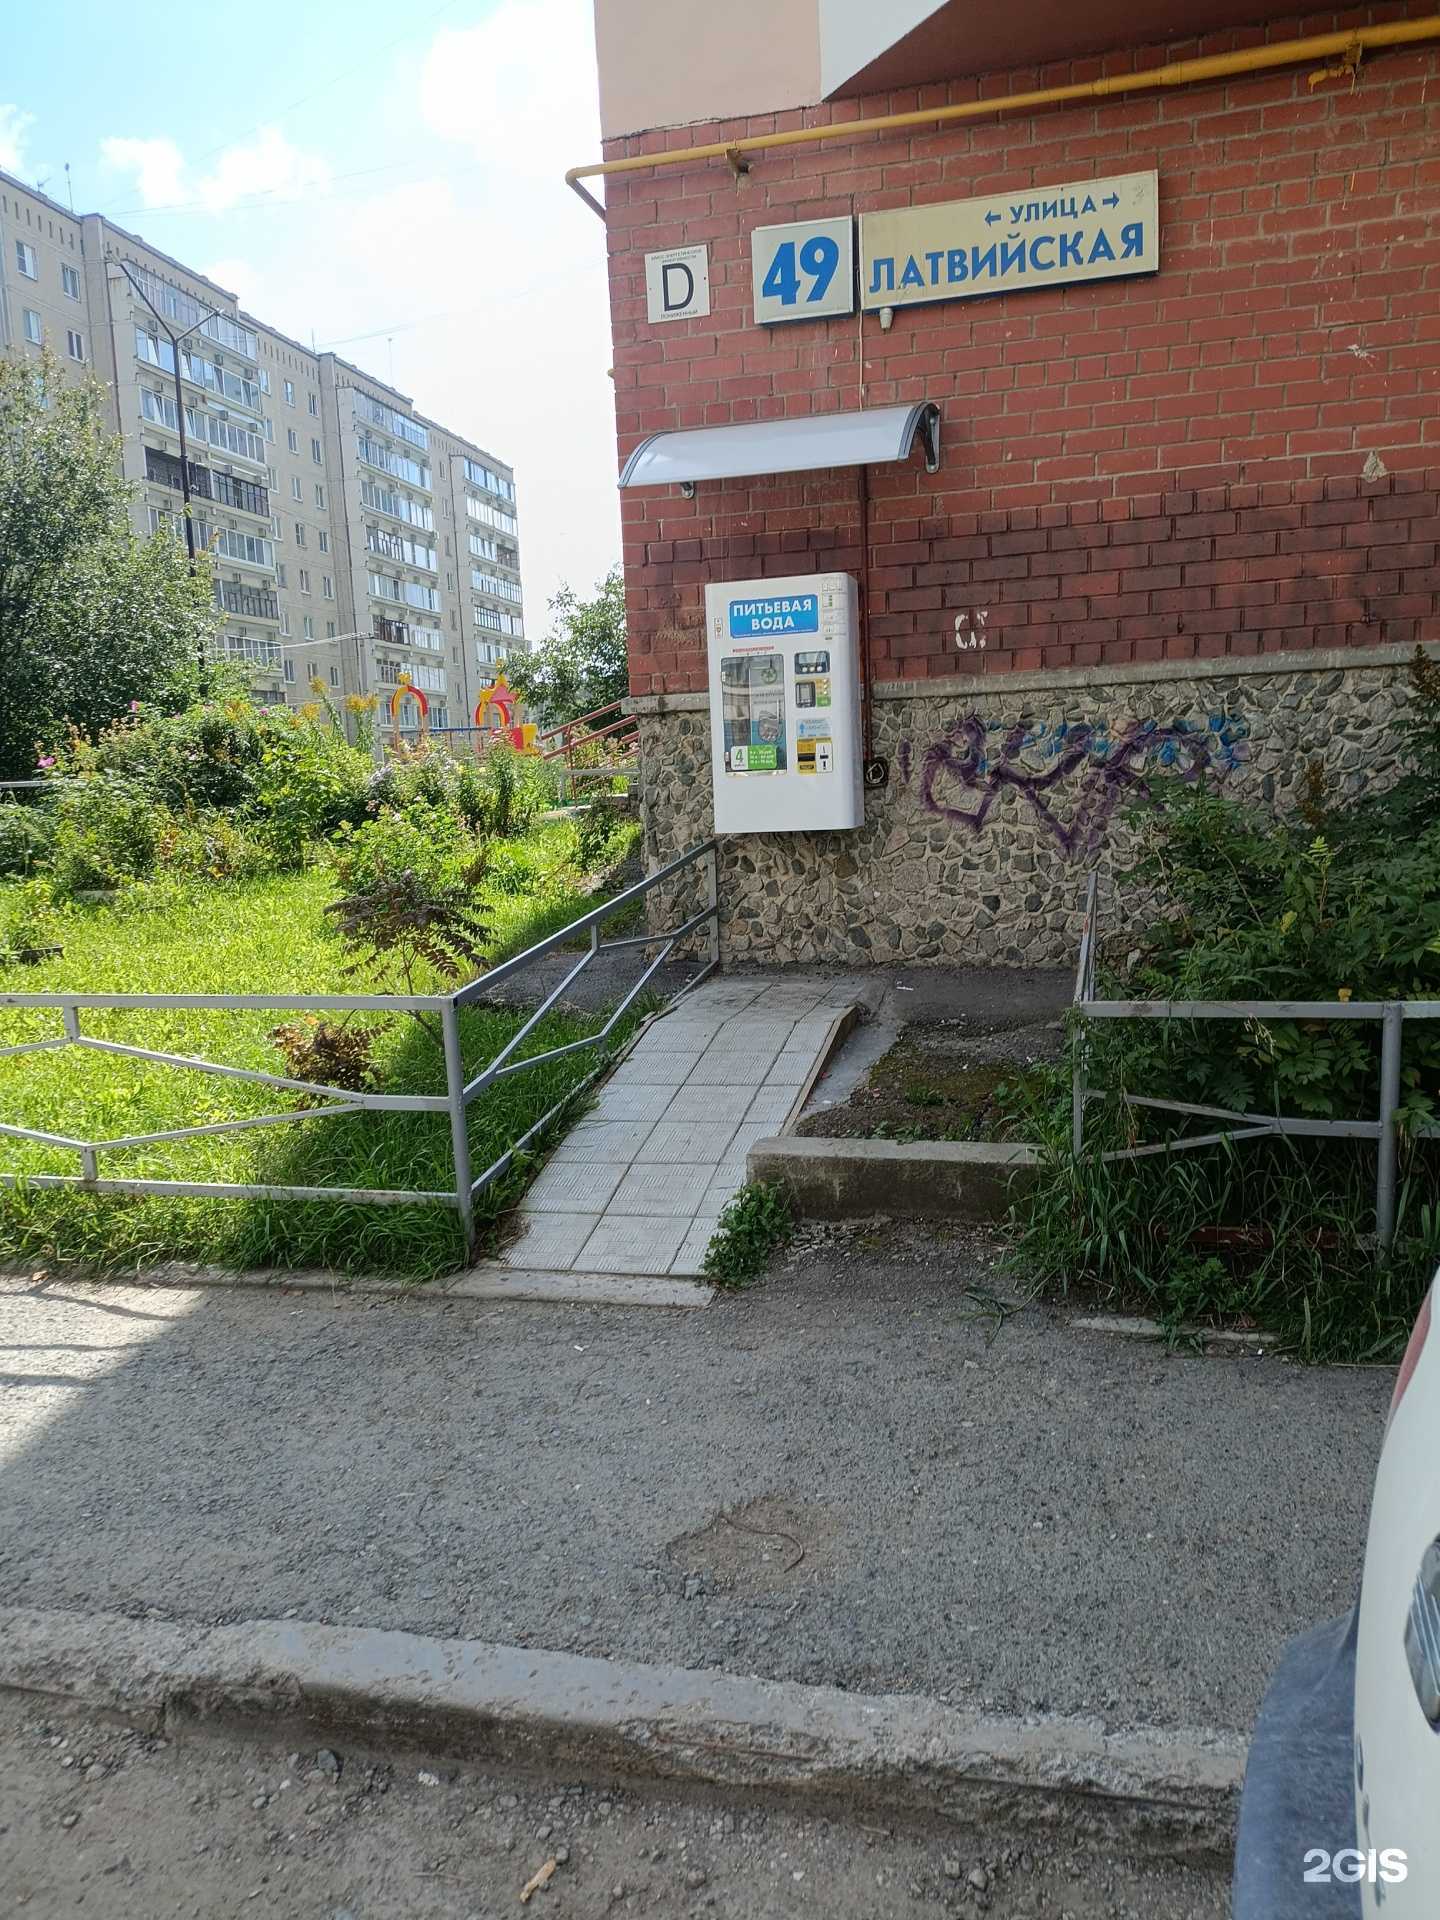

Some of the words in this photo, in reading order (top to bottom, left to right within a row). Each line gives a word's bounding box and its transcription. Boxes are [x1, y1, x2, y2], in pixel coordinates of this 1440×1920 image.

[1009, 194, 1098, 225] УЛИЦА
[761, 236, 840, 306] 49
[868, 221, 1144, 294] ЛАТВИЙСКАЯ
[661, 262, 694, 312] D
[733, 598, 812, 617] ПИТЬЕВАЯ
[751, 615, 795, 631] ВОДА
